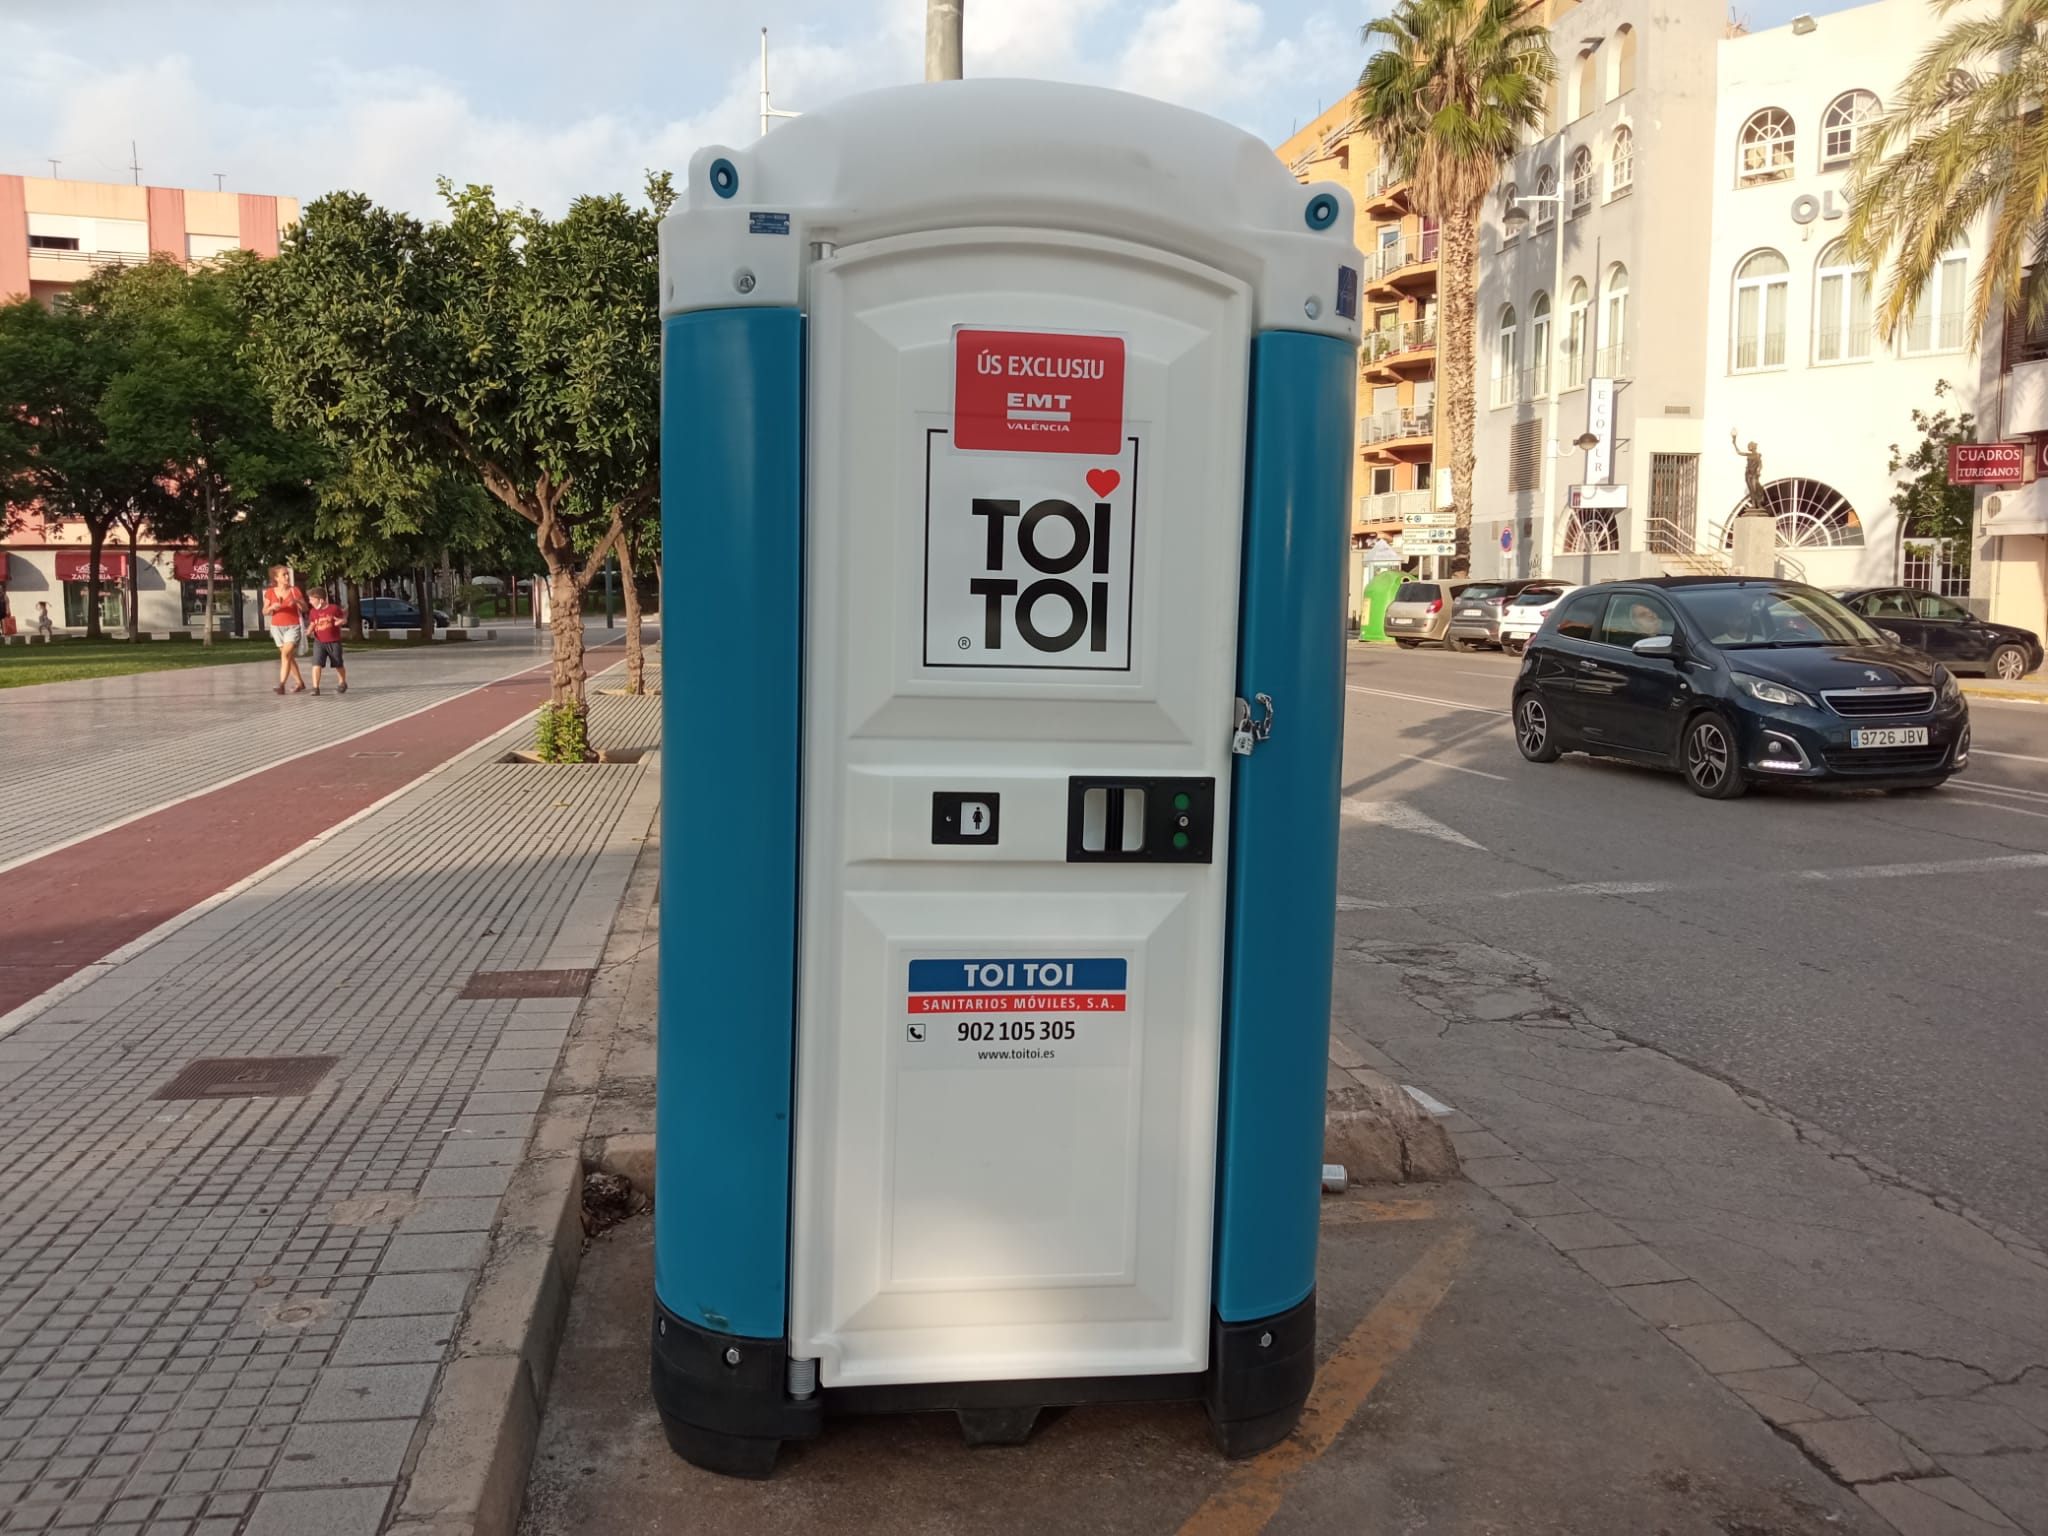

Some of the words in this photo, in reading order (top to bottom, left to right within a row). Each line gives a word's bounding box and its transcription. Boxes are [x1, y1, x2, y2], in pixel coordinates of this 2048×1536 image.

[977, 349, 1002, 375] ÚS
[1008, 356, 1104, 379] EXCLUSIU
[1007, 392, 1072, 409] EMT
[1959, 449, 2020, 462] CUADROS
[1959, 466, 2020, 477] TUREGANO'S
[972, 498, 1111, 574] TOI
[970, 578, 1108, 652] TOI
[1861, 731, 1895, 746] 9726
[1900, 730, 1923, 744] JBV
[963, 963, 1015, 987] TOI
[1023, 963, 1073, 987] TOI
[922, 997, 1008, 1011] SANITARIOS
[1013, 995, 1080, 1010] MÓVILES,
[1087, 997, 1115, 1009] S.A.
[957, 1022, 994, 1042] 902
[999, 1021, 1035, 1041] 105
[1039, 1020, 1076, 1040] 305
[977, 1048, 1055, 1060] www.toitoi.es
